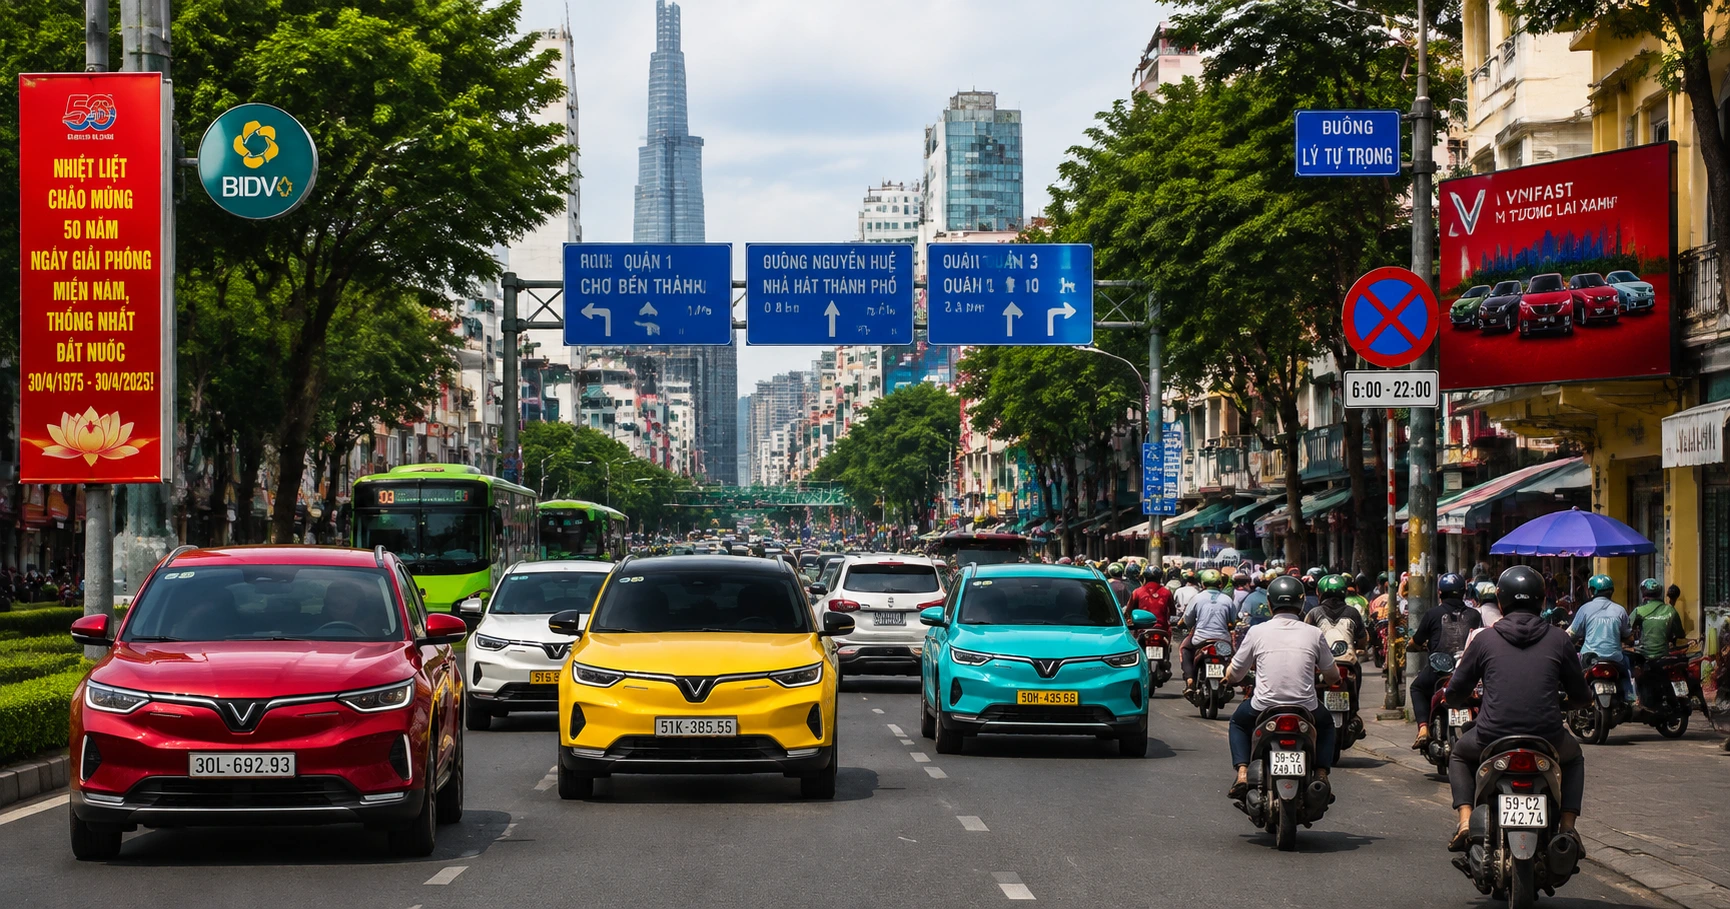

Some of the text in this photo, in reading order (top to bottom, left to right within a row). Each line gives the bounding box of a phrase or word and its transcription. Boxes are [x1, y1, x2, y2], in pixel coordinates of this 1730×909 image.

[1302, 144, 1393, 170] LÝ TỰ TRỌNG
[222, 176, 279, 197] BIDV
[1556, 200, 1577, 216] LAI
[64, 215, 118, 239] 50 NĂM
[665, 254, 672, 269] 1
[1029, 253, 1039, 269] 3
[28, 371, 84, 393] 30/4/1975
[95, 371, 154, 392] 30/4/2025!
[1352, 381, 1382, 398] 6:00
[1393, 381, 1431, 398] 22:00
[661, 720, 732, 734] 51K-385.55
[195, 757, 290, 774] 30L-692.93
[1505, 796, 1541, 811] 59-C2
[1502, 811, 1544, 825] 742.74
